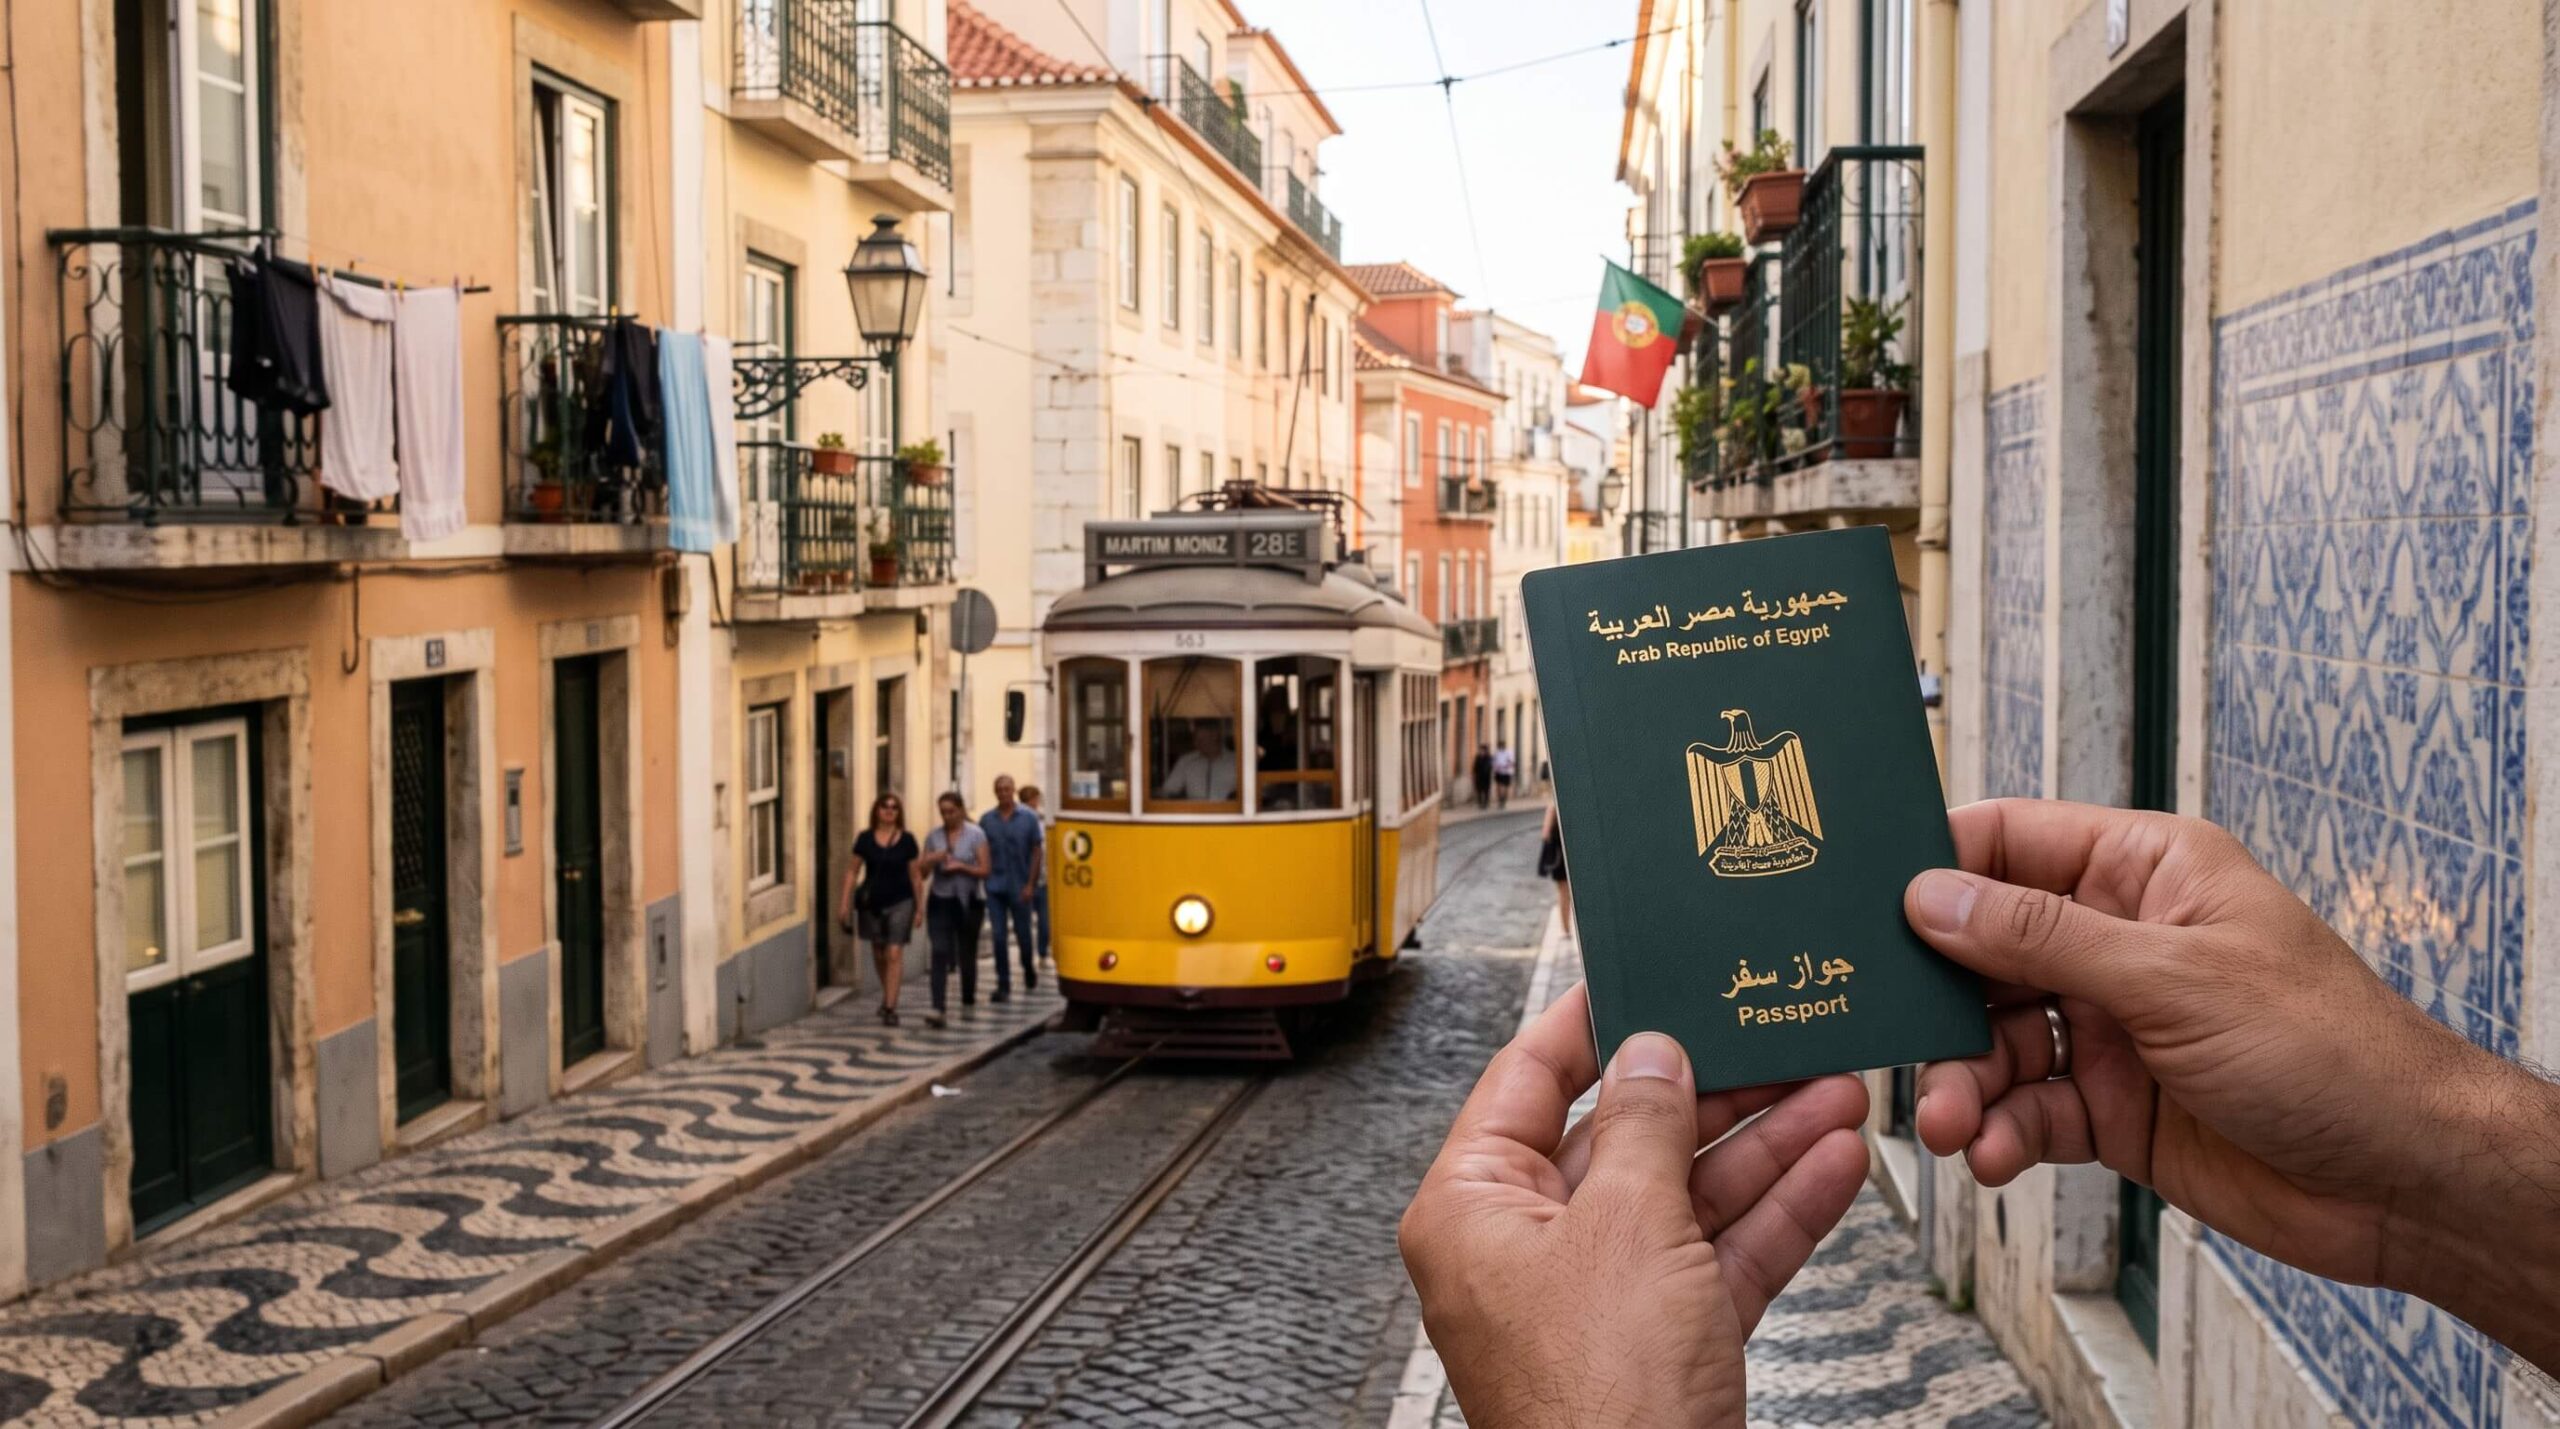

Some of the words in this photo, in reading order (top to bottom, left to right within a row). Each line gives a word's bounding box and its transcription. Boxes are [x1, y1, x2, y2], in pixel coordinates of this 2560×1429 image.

[1105, 535, 1171, 554] MARTIM
[1174, 535, 1228, 554] MONIZ
[1251, 533, 1299, 556] 28E
[1679, 604, 1736, 631] مصر
[1742, 589, 1848, 621] جمهورية
[1588, 604, 1671, 641] العربية
[1616, 645, 1661, 665] Arab
[1665, 634, 1748, 660] Republic
[1752, 629, 1772, 647] of
[1775, 622, 1831, 647] Egypt
[1720, 959, 1778, 999] سفر
[1788, 951, 1855, 990] جواز
[1738, 993, 1849, 1027] Passport
